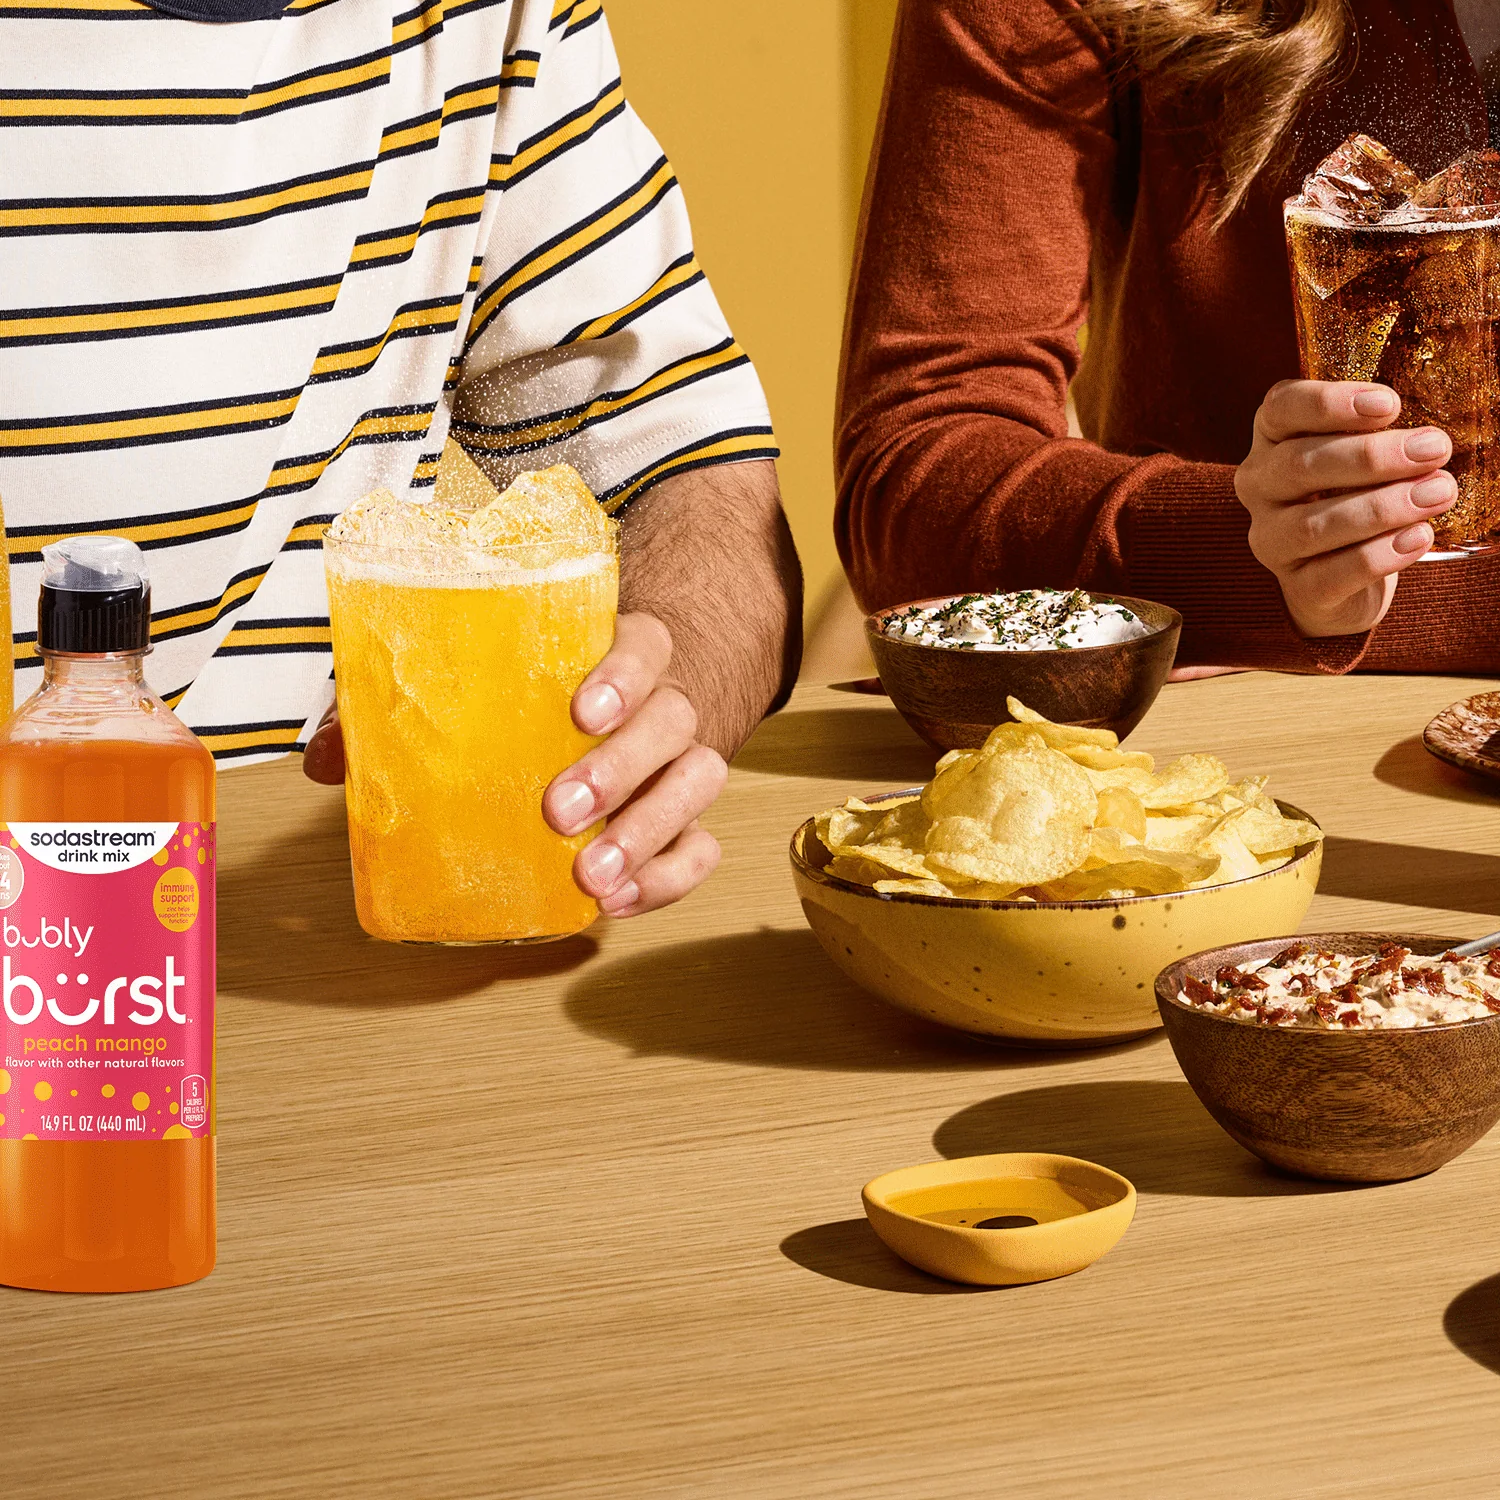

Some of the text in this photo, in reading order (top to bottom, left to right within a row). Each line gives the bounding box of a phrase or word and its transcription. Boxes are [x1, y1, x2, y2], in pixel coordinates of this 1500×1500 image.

[30, 829, 155, 847] sodastream
[58, 849, 130, 863] drink mix
[160, 883, 194, 892] immune
[160, 892, 195, 904] support
[3, 917, 94, 957] bubly
[24, 1034, 167, 1056] peach mango
[5, 1056, 185, 1068] flavor with other natural flavors
[192, 1082, 198, 1097] 5
[40, 1115, 146, 1133] 14.9 FL OZ (440 mL)
